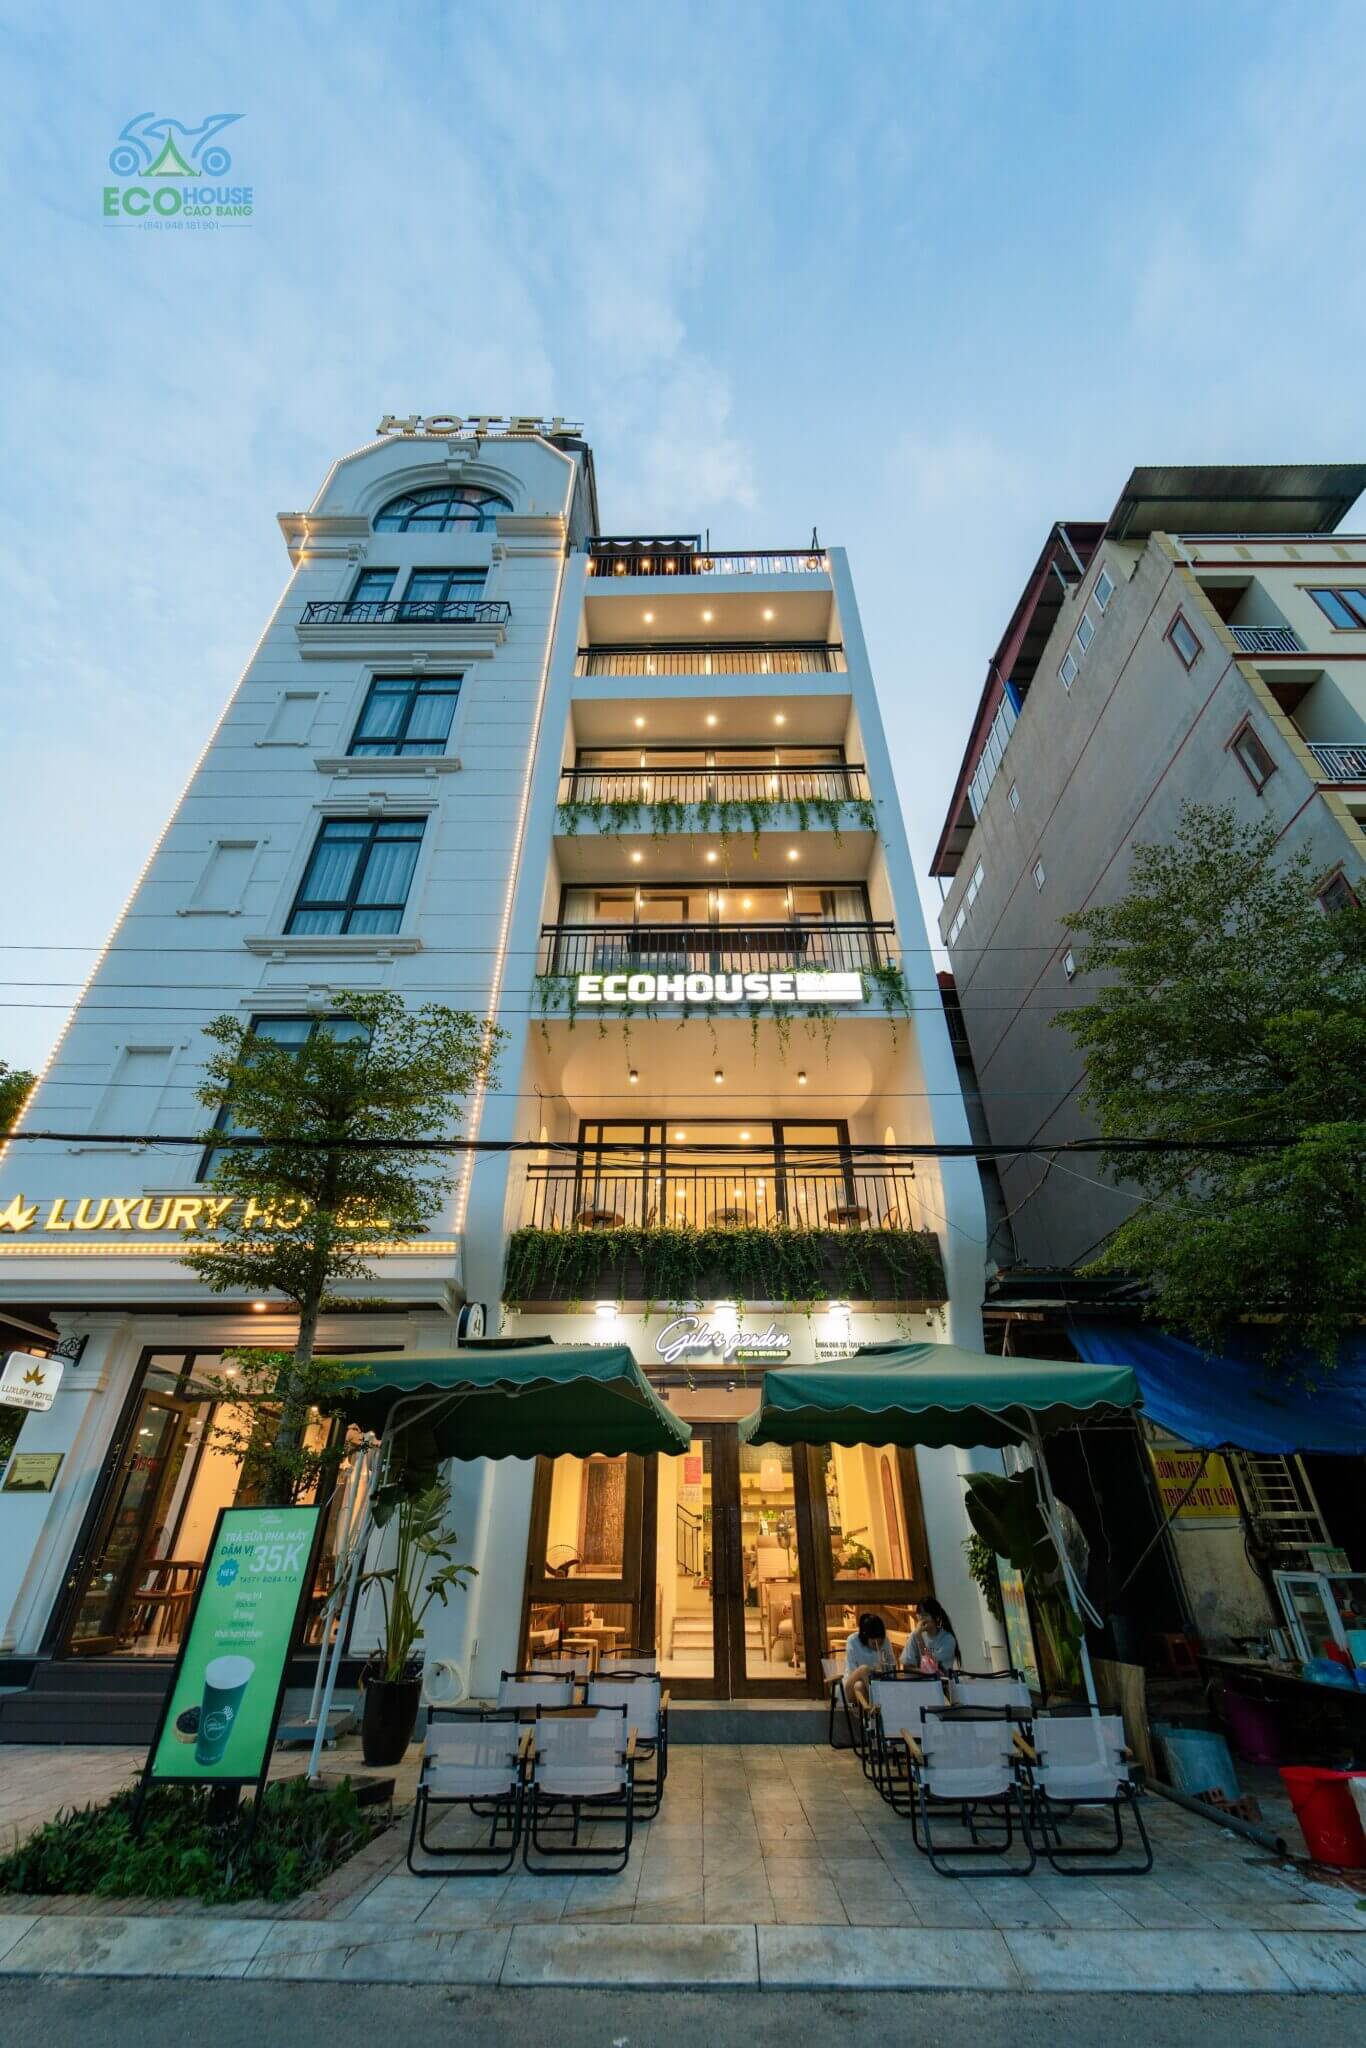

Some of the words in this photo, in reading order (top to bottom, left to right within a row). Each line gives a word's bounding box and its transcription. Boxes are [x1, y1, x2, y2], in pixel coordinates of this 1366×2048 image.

[376, 415, 584, 438] HOTEL
[577, 974, 797, 1001] ECOHOUSE
[45, 1198, 233, 1231] LUXURY
[724, 1322, 792, 1358] garden
[1, 1385, 30, 1395] LUXURY
[31, 1391, 53, 1402] HOTEL
[249, 1543, 305, 1573] 35K
[220, 1568, 236, 1577] NEW
